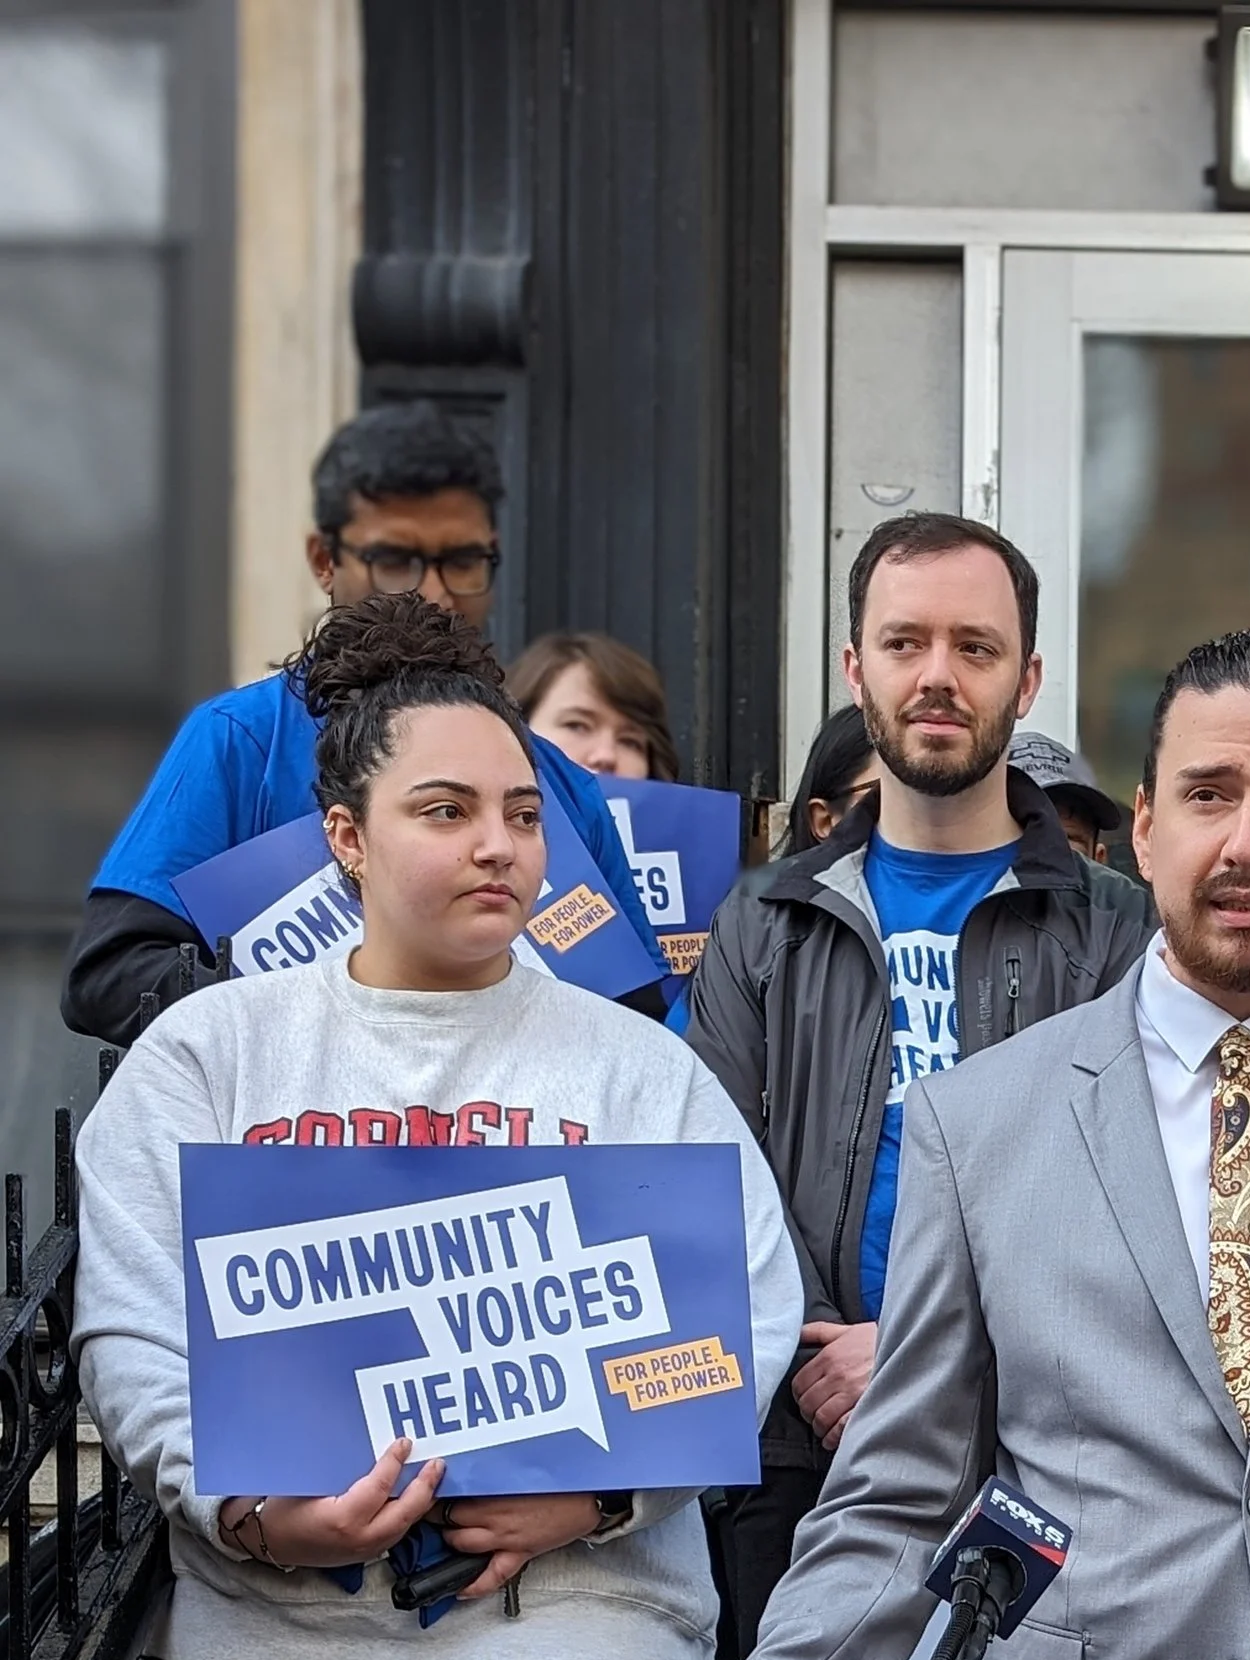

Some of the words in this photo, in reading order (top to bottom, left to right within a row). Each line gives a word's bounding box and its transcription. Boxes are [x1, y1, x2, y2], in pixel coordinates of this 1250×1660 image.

[533, 918, 555, 938] FOR
[555, 892, 593, 925] PEOPLE.
[552, 926, 576, 947] FOR
[575, 903, 610, 934] POWER.
[225, 1201, 553, 1316] COMMUNITY
[437, 1261, 645, 1354] VOICES
[613, 1362, 649, 1385] FOR
[650, 1346, 719, 1376] PEOPLE.
[634, 1379, 669, 1403] FOR
[671, 1366, 736, 1394] POWER.
[382, 1352, 568, 1440] HEARD
[991, 1488, 1046, 1533] FOX
